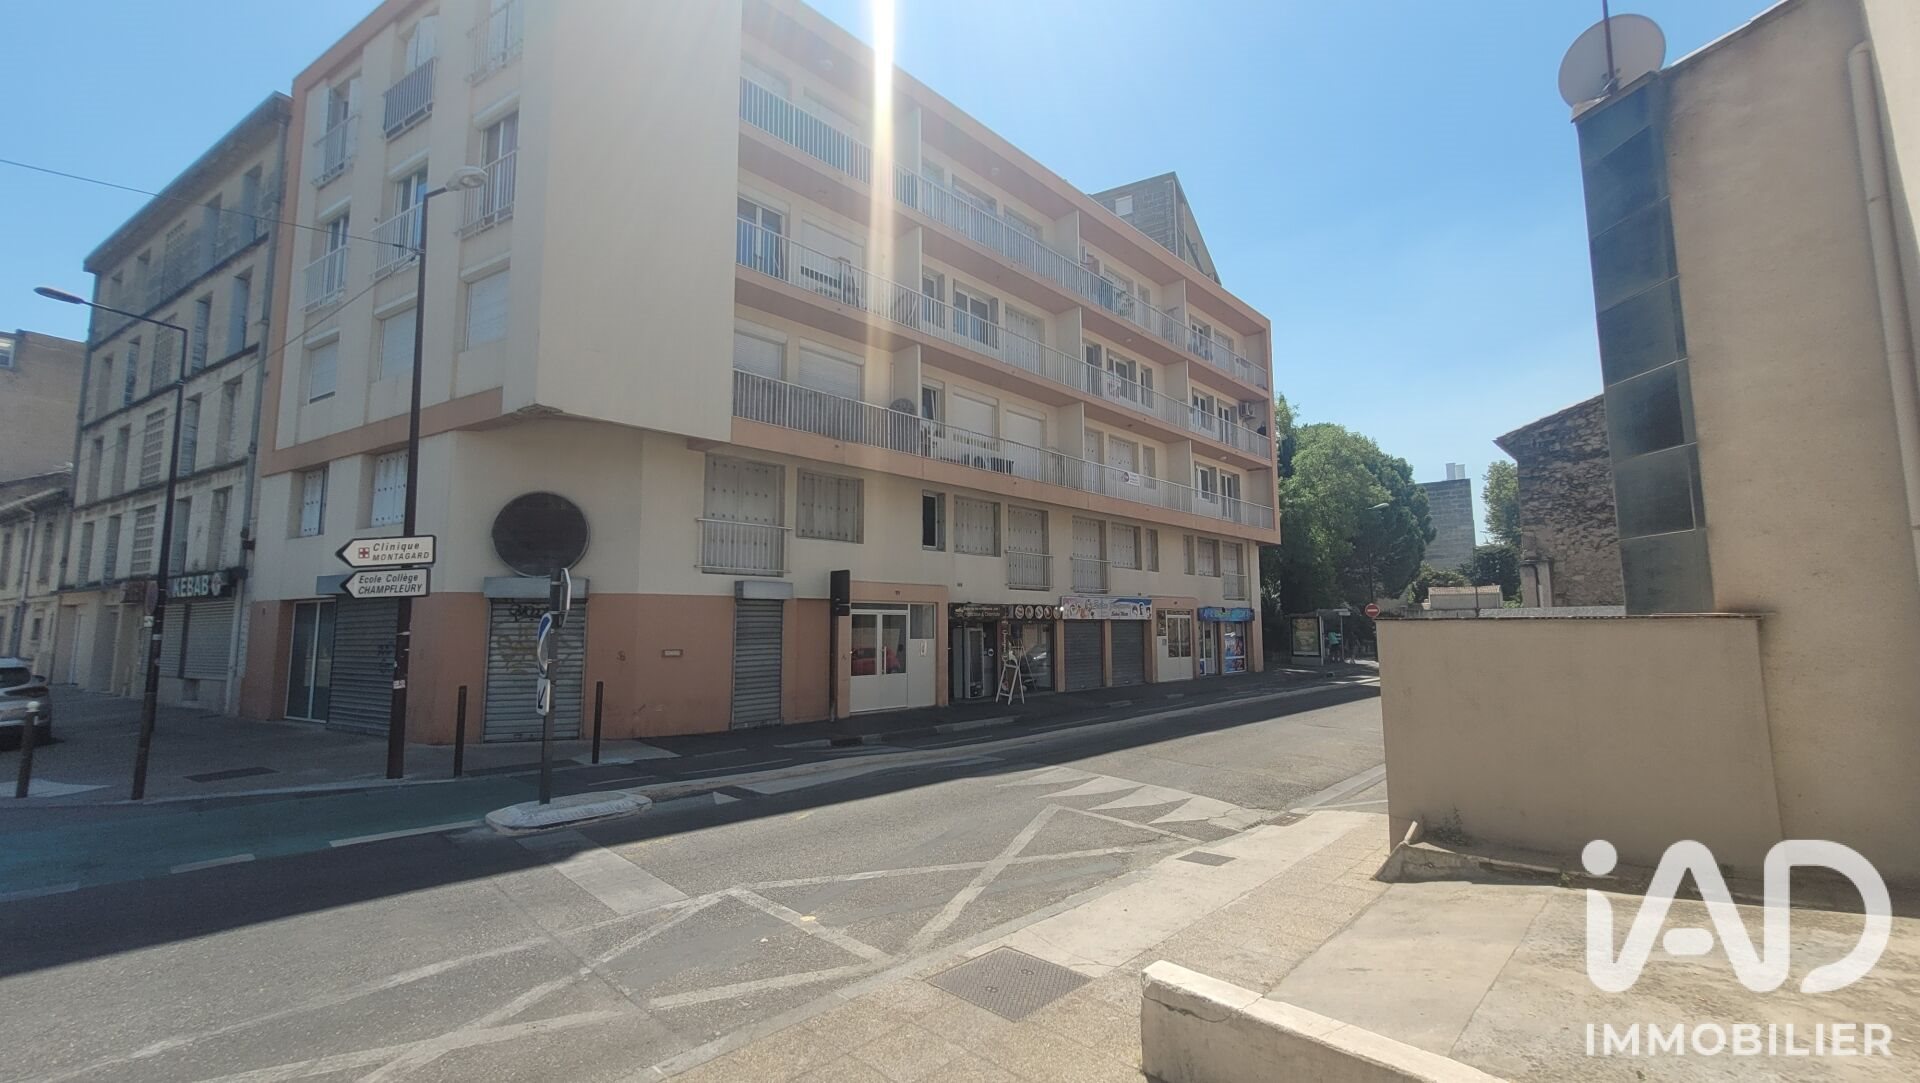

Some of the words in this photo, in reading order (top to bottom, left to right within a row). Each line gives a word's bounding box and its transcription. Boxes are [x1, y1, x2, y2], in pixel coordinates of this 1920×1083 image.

[373, 542, 420, 552] Clinique
[372, 551, 430, 561] MONTAGARD
[358, 574, 382, 584] Ecole
[385, 573, 419, 584] Collège
[173, 575, 209, 597] KEBAB
[358, 583, 423, 595] CHAMPFLEURY
